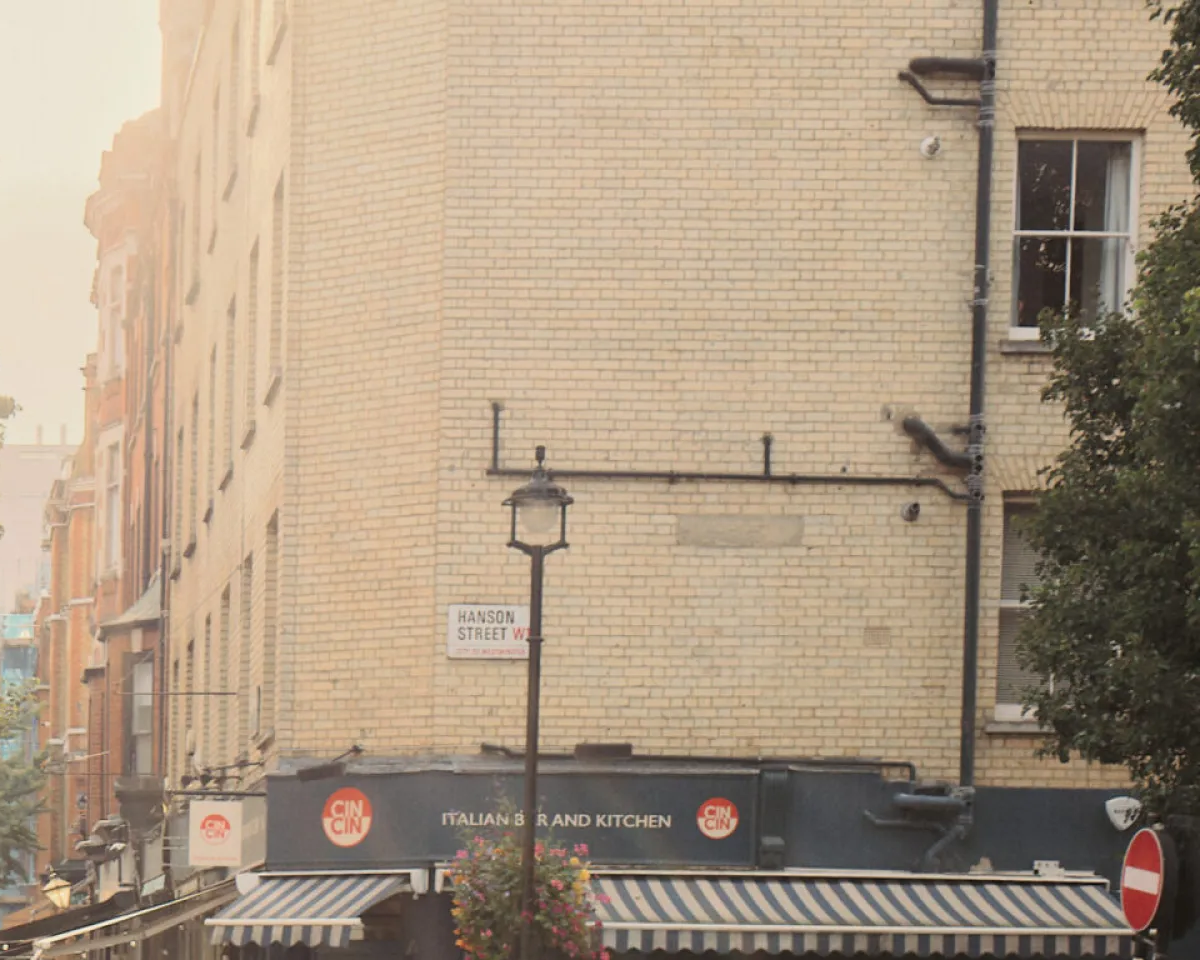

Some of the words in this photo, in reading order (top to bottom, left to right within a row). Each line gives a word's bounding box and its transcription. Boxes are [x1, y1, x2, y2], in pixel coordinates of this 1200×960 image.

[458, 610, 514, 624] HANSON
[458, 627, 507, 640] STREET
[330, 799, 363, 817] CIN
[704, 805, 732, 818] CIN
[330, 817, 362, 835] CIN
[442, 812, 509, 826] ITALIAN
[514, 813, 548, 826] BR
[552, 814, 591, 827] AND
[596, 814, 672, 828] KITCHEN
[704, 818, 730, 830] CIN
